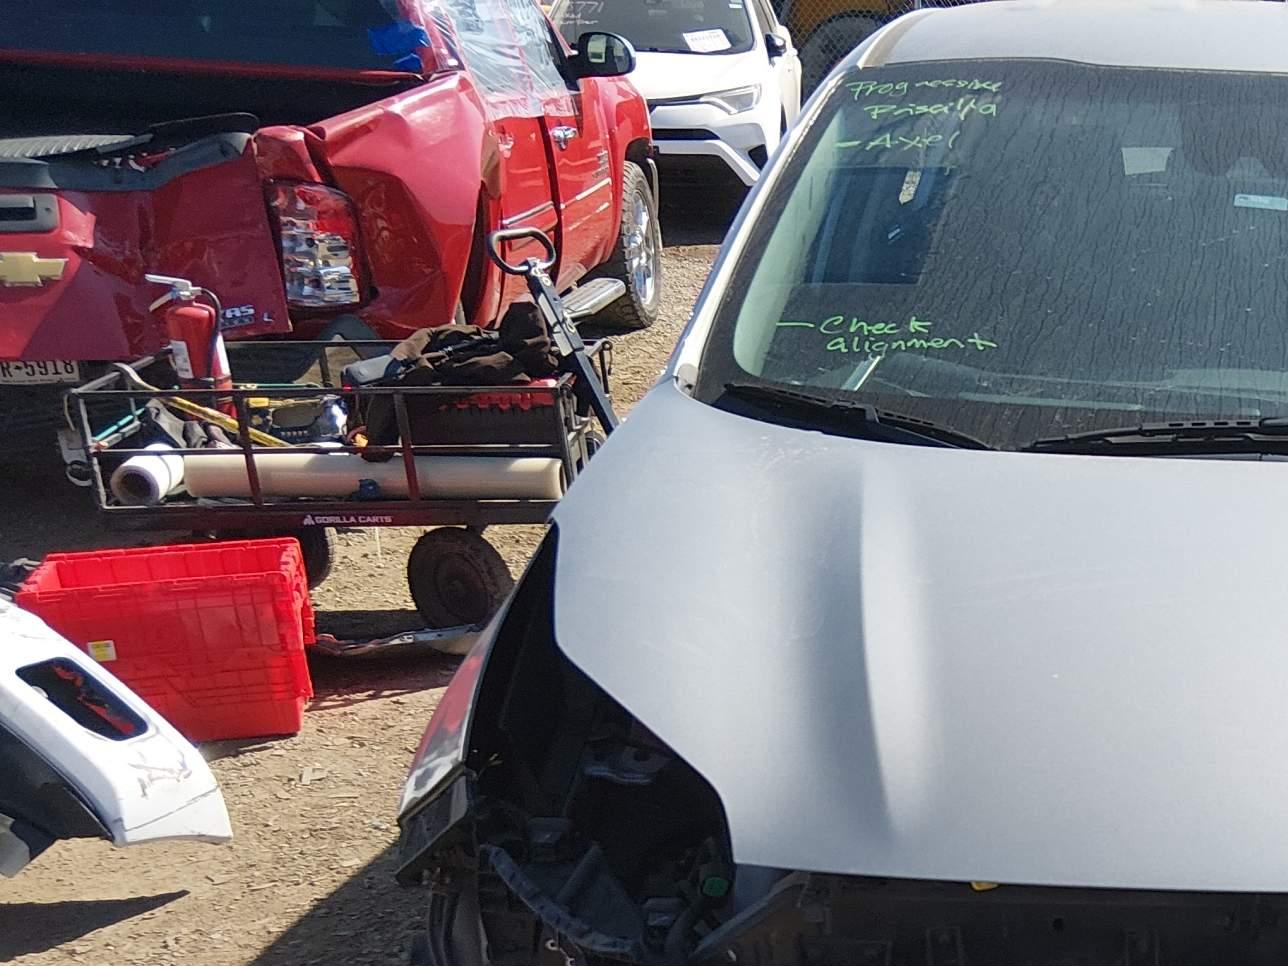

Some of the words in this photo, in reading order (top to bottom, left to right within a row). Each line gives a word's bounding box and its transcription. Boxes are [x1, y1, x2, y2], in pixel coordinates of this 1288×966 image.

[819, 316, 932, 334] Check
[826, 332, 998, 360] alignment
[314, 515, 357, 524] GORILLA
[358, 515, 393, 523] CARTS
